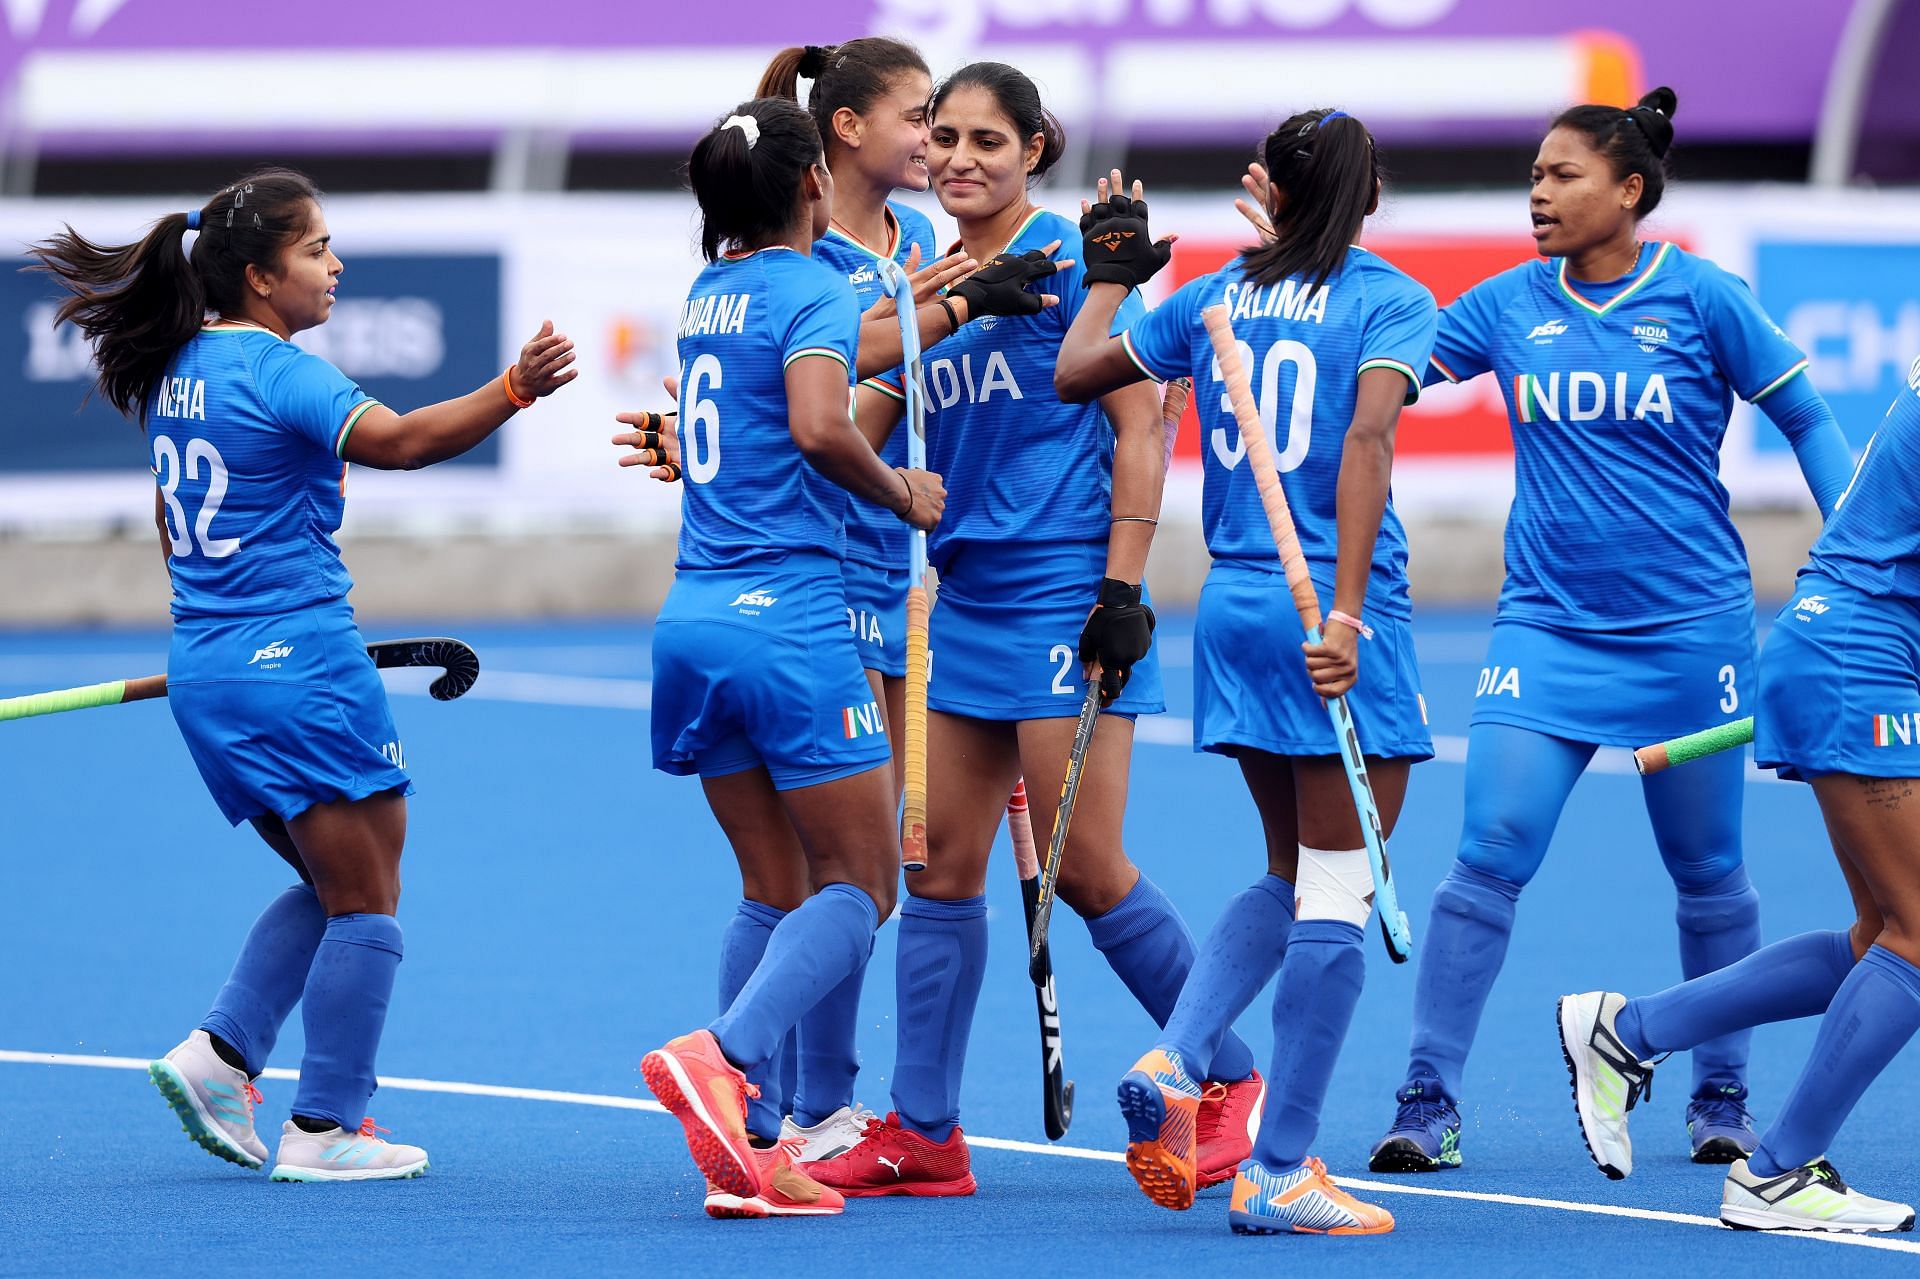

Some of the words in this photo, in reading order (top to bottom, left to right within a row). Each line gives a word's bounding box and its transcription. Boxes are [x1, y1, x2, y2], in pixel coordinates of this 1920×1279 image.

[1223, 280, 1330, 324] SALIMA
[1632, 326, 1669, 339] INDIA
[157, 376, 206, 421] NEHA
[1212, 340, 1317, 473] 30
[1513, 372, 1674, 423] INDIA
[153, 435, 241, 557] 32
[728, 591, 778, 608] JSW
[1792, 595, 1831, 615] JSW
[247, 643, 295, 665] JSW
[260, 662, 282, 670] Inspire
[1049, 644, 1075, 694] 2
[1718, 664, 1739, 714] 3
